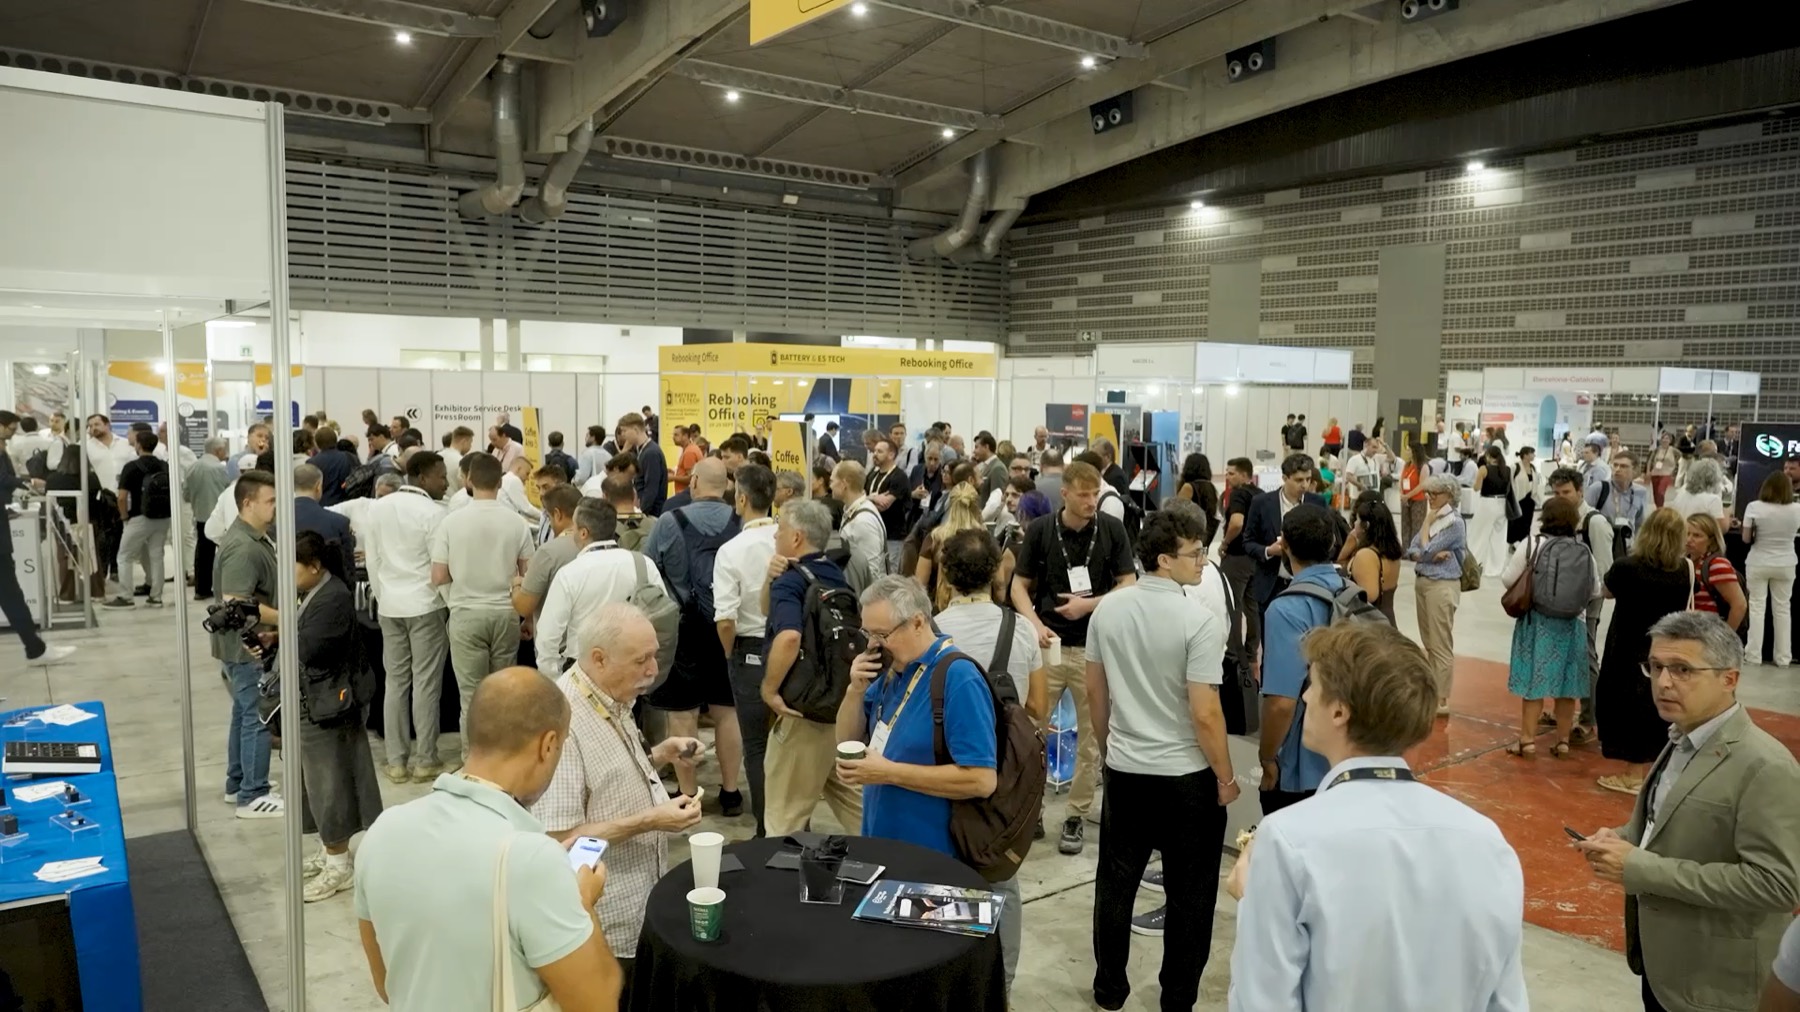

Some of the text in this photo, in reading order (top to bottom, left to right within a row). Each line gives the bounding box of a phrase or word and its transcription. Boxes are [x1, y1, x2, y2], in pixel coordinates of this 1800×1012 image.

[672, 352, 719, 366] Rebooking Office
[780, 354, 811, 362] BATTERY
[828, 355, 845, 363] TECH
[900, 357, 973, 371] Rebooking Office
[435, 404, 471, 413] Exhibitor
[474, 405, 502, 413] Service
[775, 450, 800, 465] Coffee
